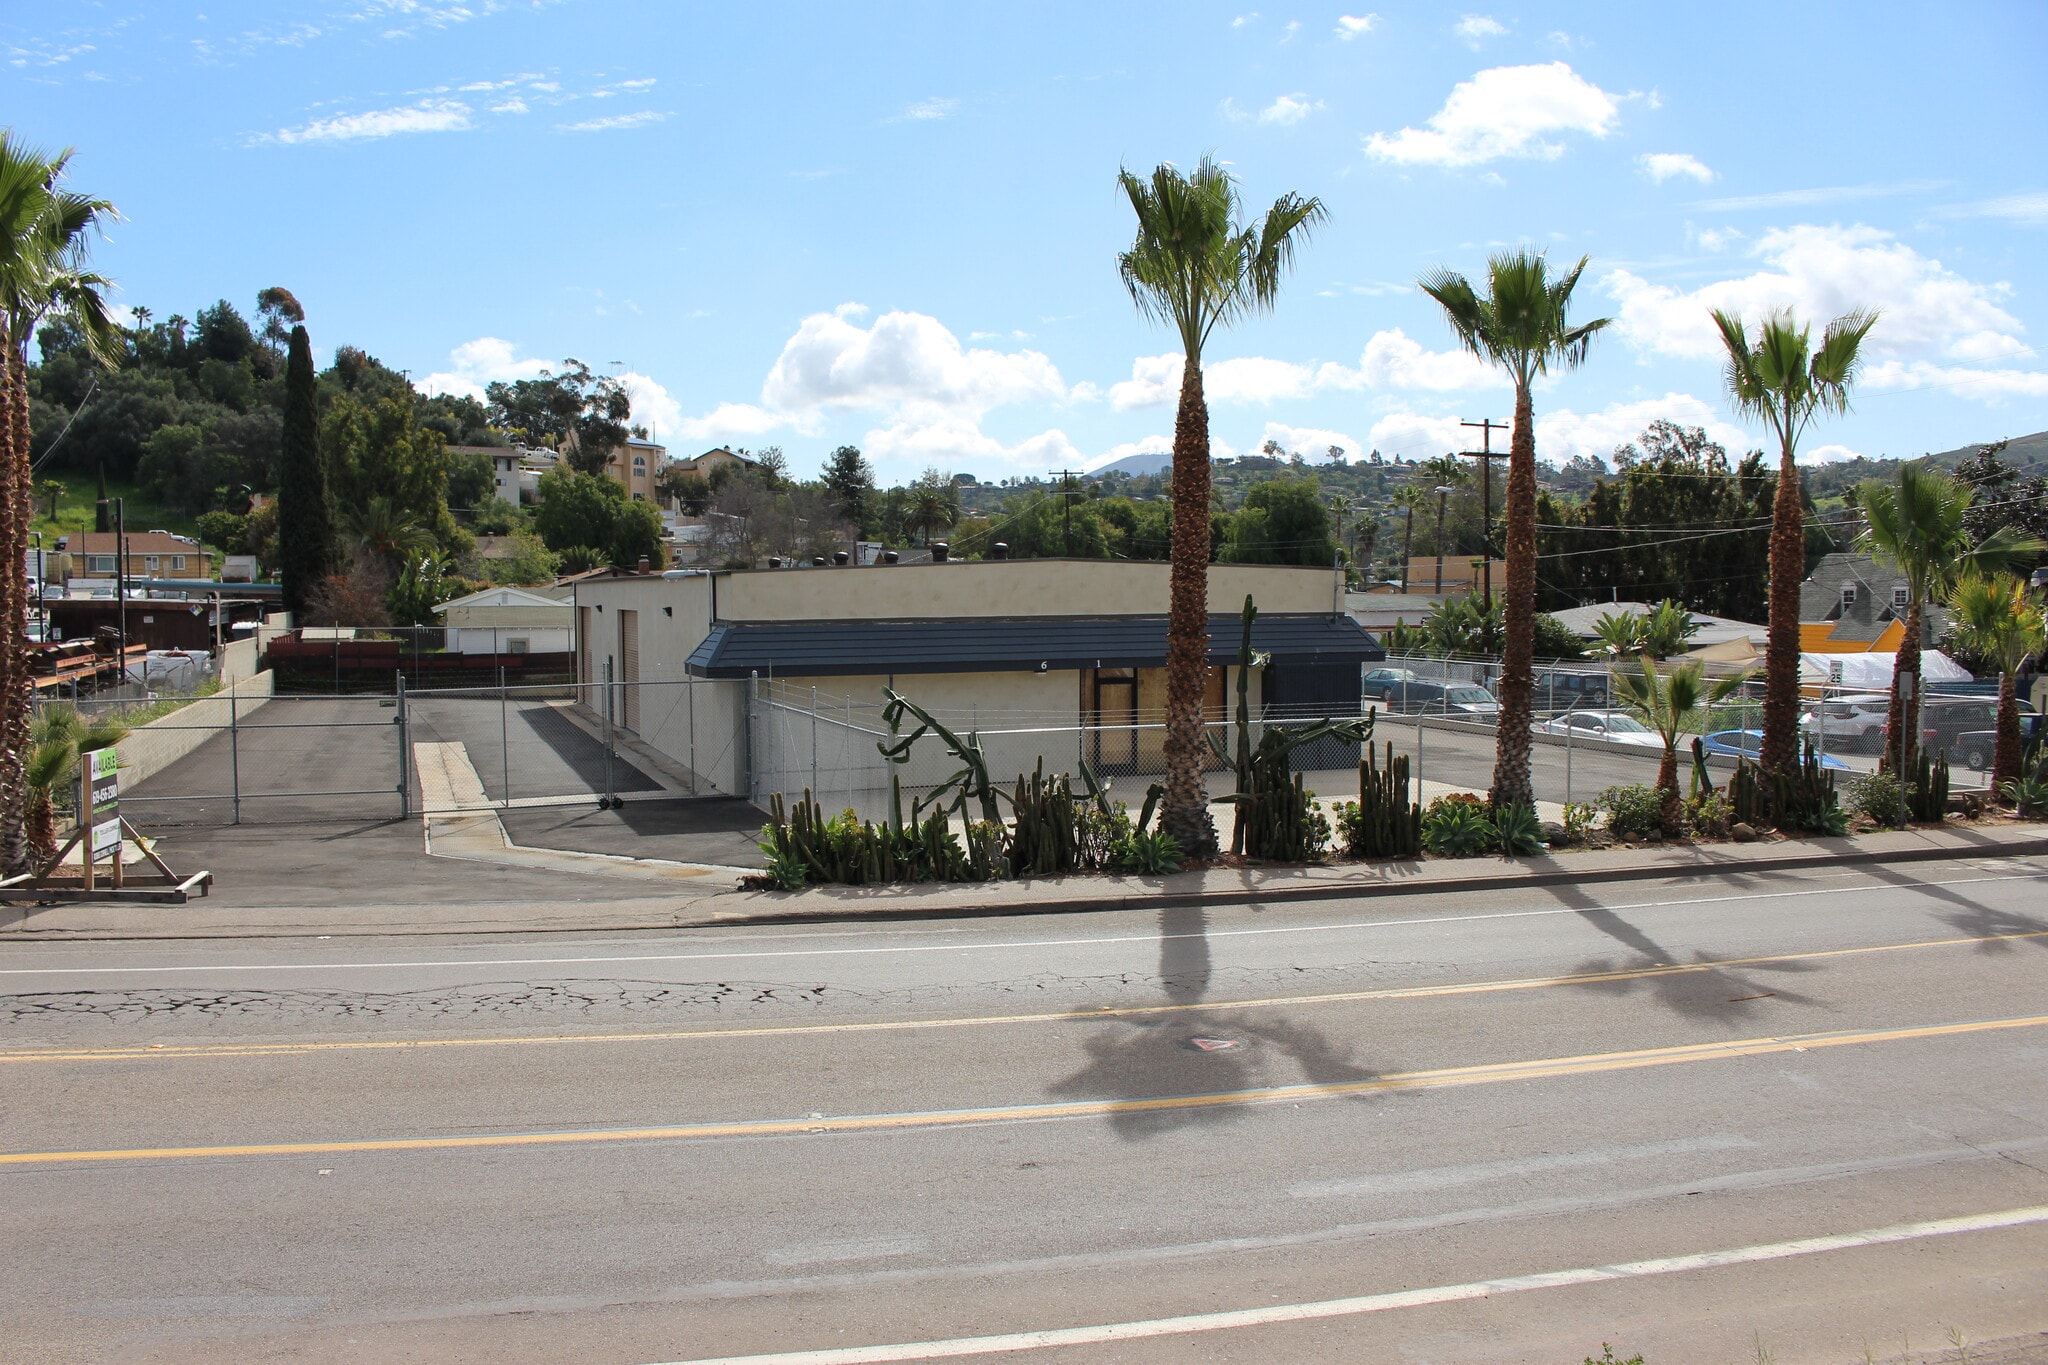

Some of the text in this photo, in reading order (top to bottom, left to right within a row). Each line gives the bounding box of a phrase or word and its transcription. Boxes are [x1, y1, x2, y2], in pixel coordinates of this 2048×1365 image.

[1041, 659, 1101, 669] 6 1
[1831, 674, 1840, 683] 25
[93, 756, 115, 774] AVAILABLE
